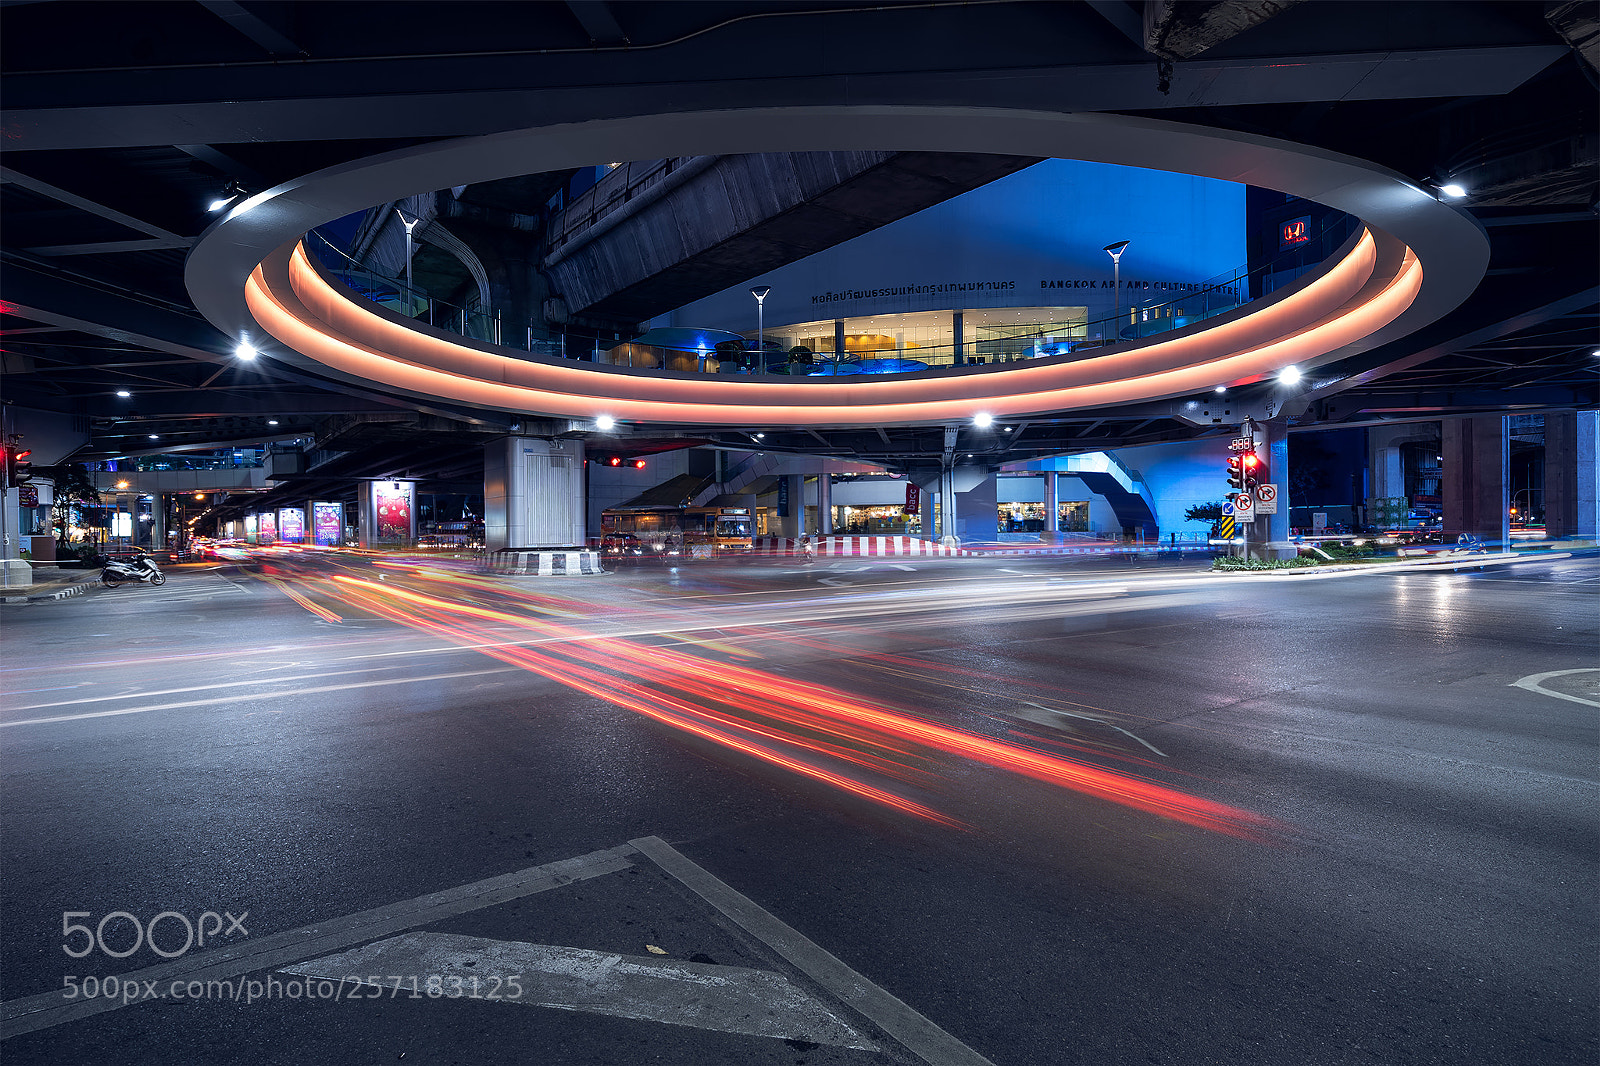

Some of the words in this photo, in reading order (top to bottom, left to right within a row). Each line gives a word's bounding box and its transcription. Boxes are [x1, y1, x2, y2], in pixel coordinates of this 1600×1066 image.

[1040, 280, 1096, 289] BANGKOK
[1101, 280, 1122, 289] ART
[1127, 280, 1149, 290] AND
[1153, 281, 1198, 292] CULTURE
[1202, 283, 1239, 296] CENTRE
[907, 489, 917, 511] bacc
